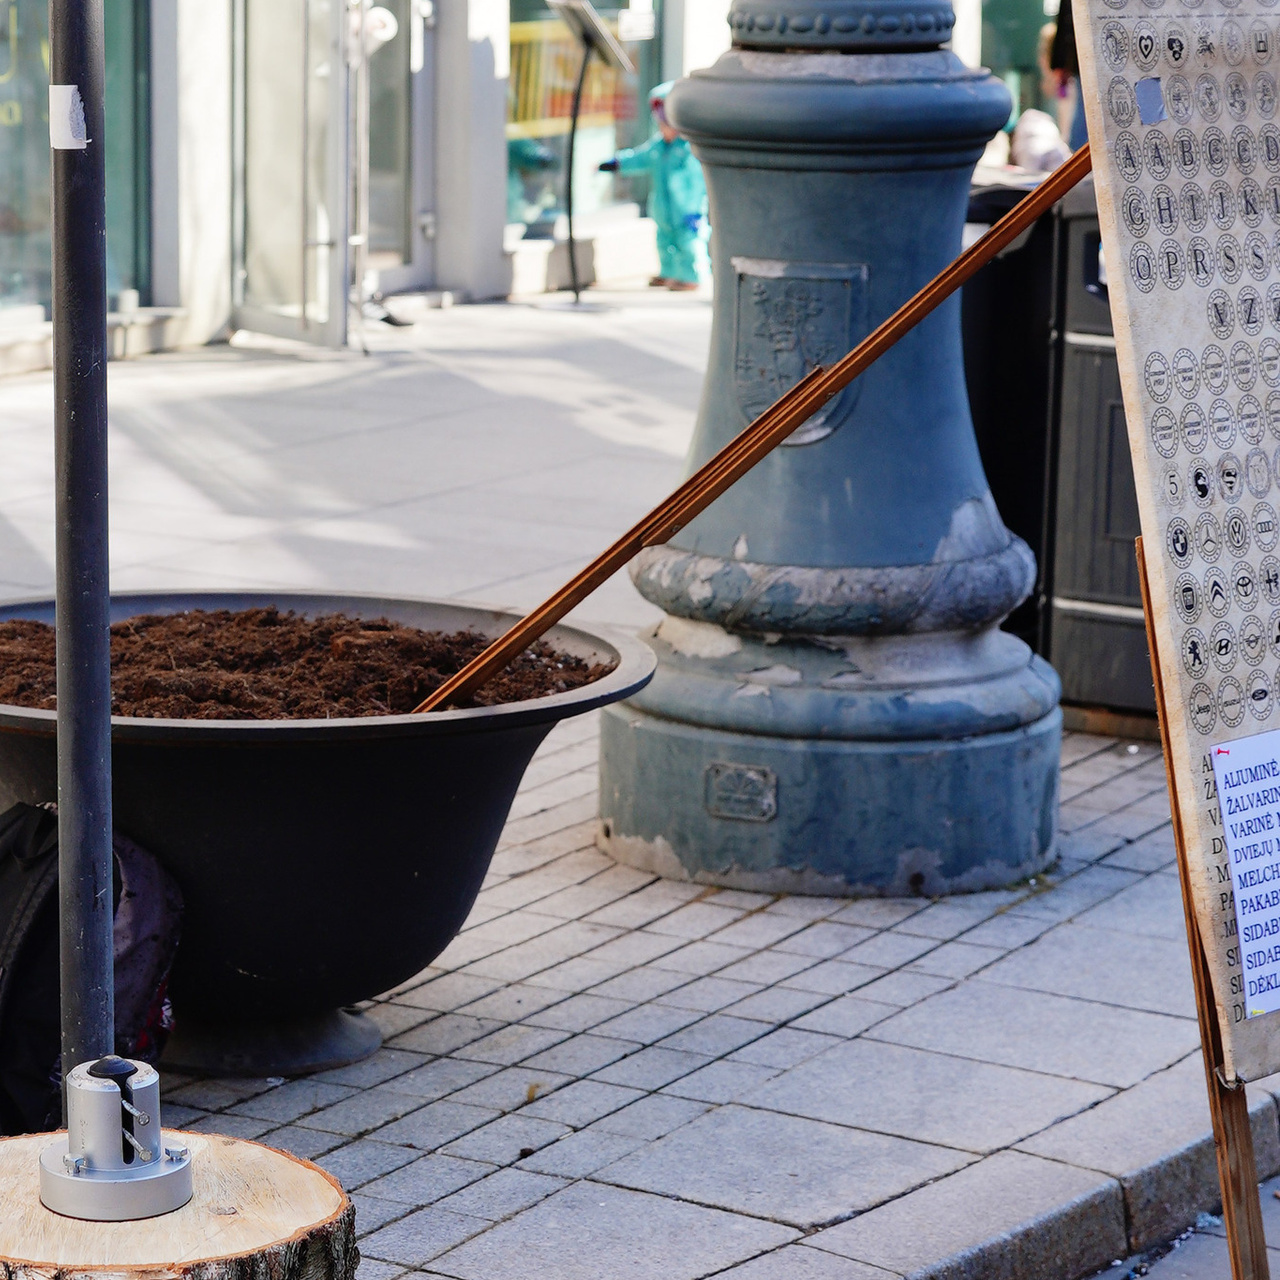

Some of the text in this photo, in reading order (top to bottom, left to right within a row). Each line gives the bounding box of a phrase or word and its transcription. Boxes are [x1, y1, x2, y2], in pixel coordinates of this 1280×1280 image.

[1180, 139, 1194, 166] B
[1157, 197, 1173, 224] H
[1243, 189, 1258, 215] K
[1166, 251, 1178, 279] P
[1193, 249, 1209, 275] R
[1196, 704, 1211, 716] Jeep
[1224, 758, 1280, 790] ALIUMINĖ
[1226, 786, 1280, 815] ŽALVARIN
[1230, 811, 1274, 839] VARINĖ
[1234, 839, 1274, 864] DVIEJŲ
[1240, 889, 1280, 915] PAKAB
[1243, 917, 1280, 943] SIDAB
